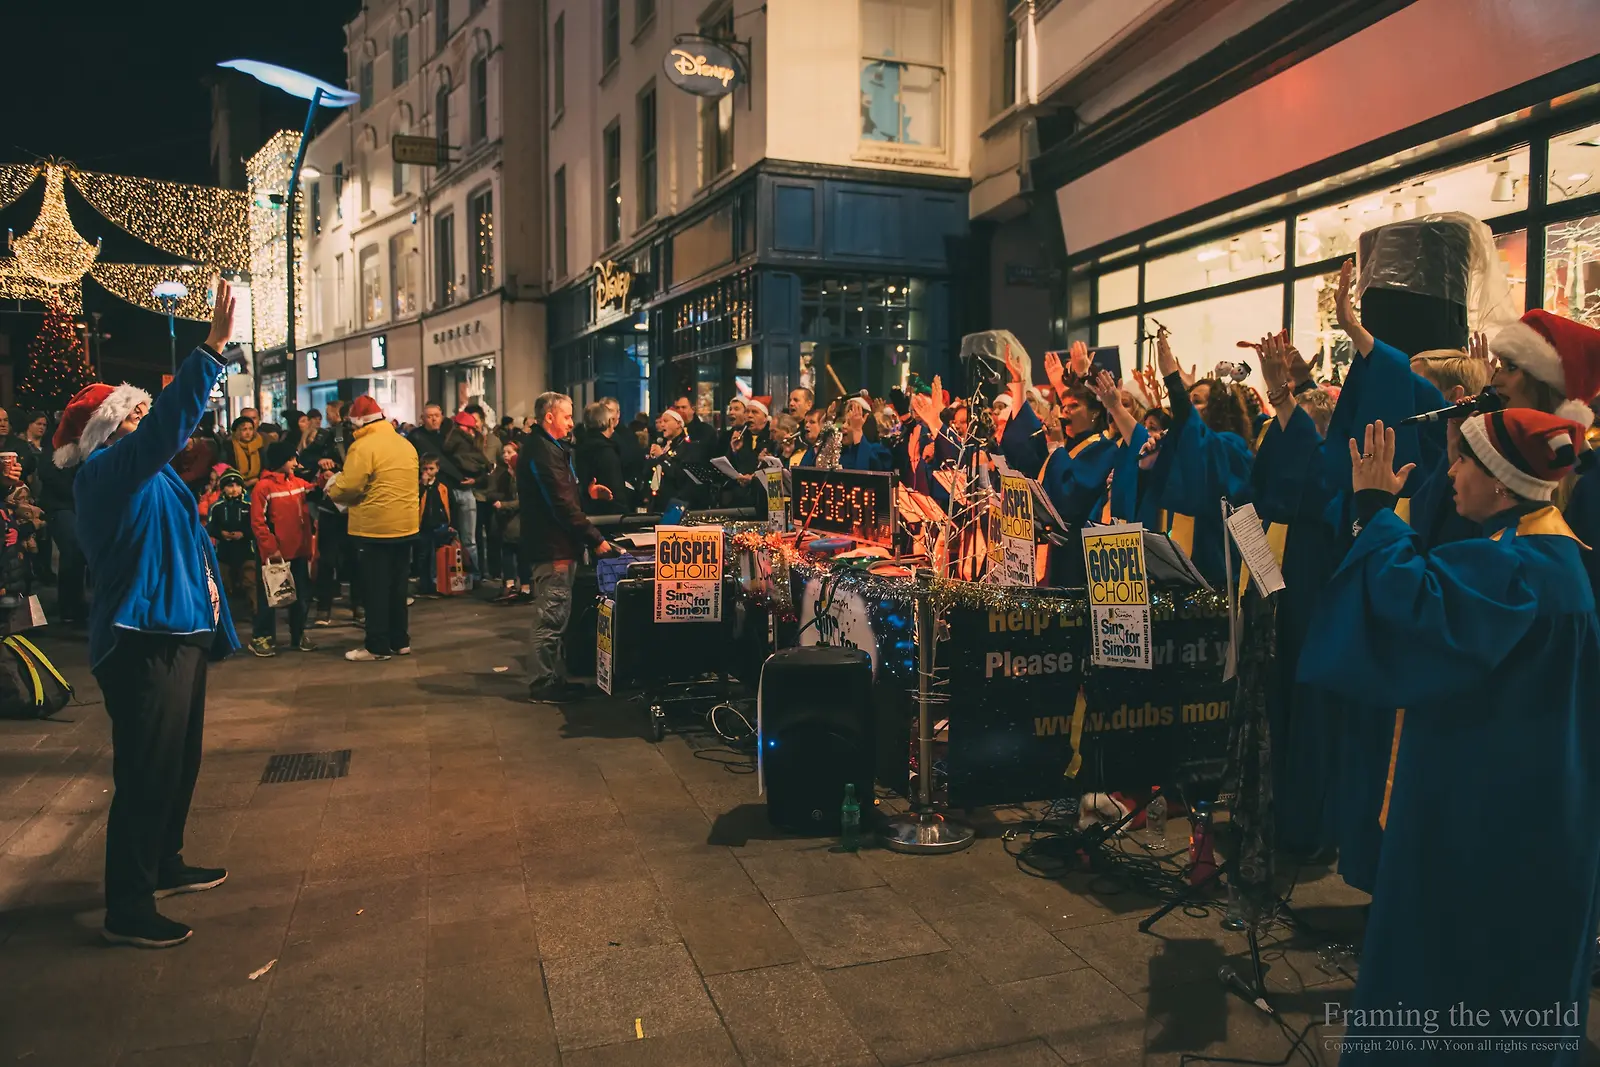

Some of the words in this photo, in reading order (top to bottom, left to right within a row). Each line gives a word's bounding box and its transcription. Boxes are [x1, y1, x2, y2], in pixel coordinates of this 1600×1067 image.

[671, 49, 734, 87] Disney
[593, 260, 631, 314] Disney
[433, 320, 480, 344] SISLEY
[660, 540, 719, 564] GOSPEL
[1115, 537, 1140, 548] LUCAN
[659, 564, 718, 579] CHOIR
[1088, 547, 1143, 583] GOSPEL
[693, 596, 710, 606] for
[1092, 582, 1145, 603] CHOIR
[665, 604, 710, 616] Simon
[1101, 639, 1141, 658] Simon
[1124, 631, 1140, 645] for
[985, 651, 1073, 679] Please
